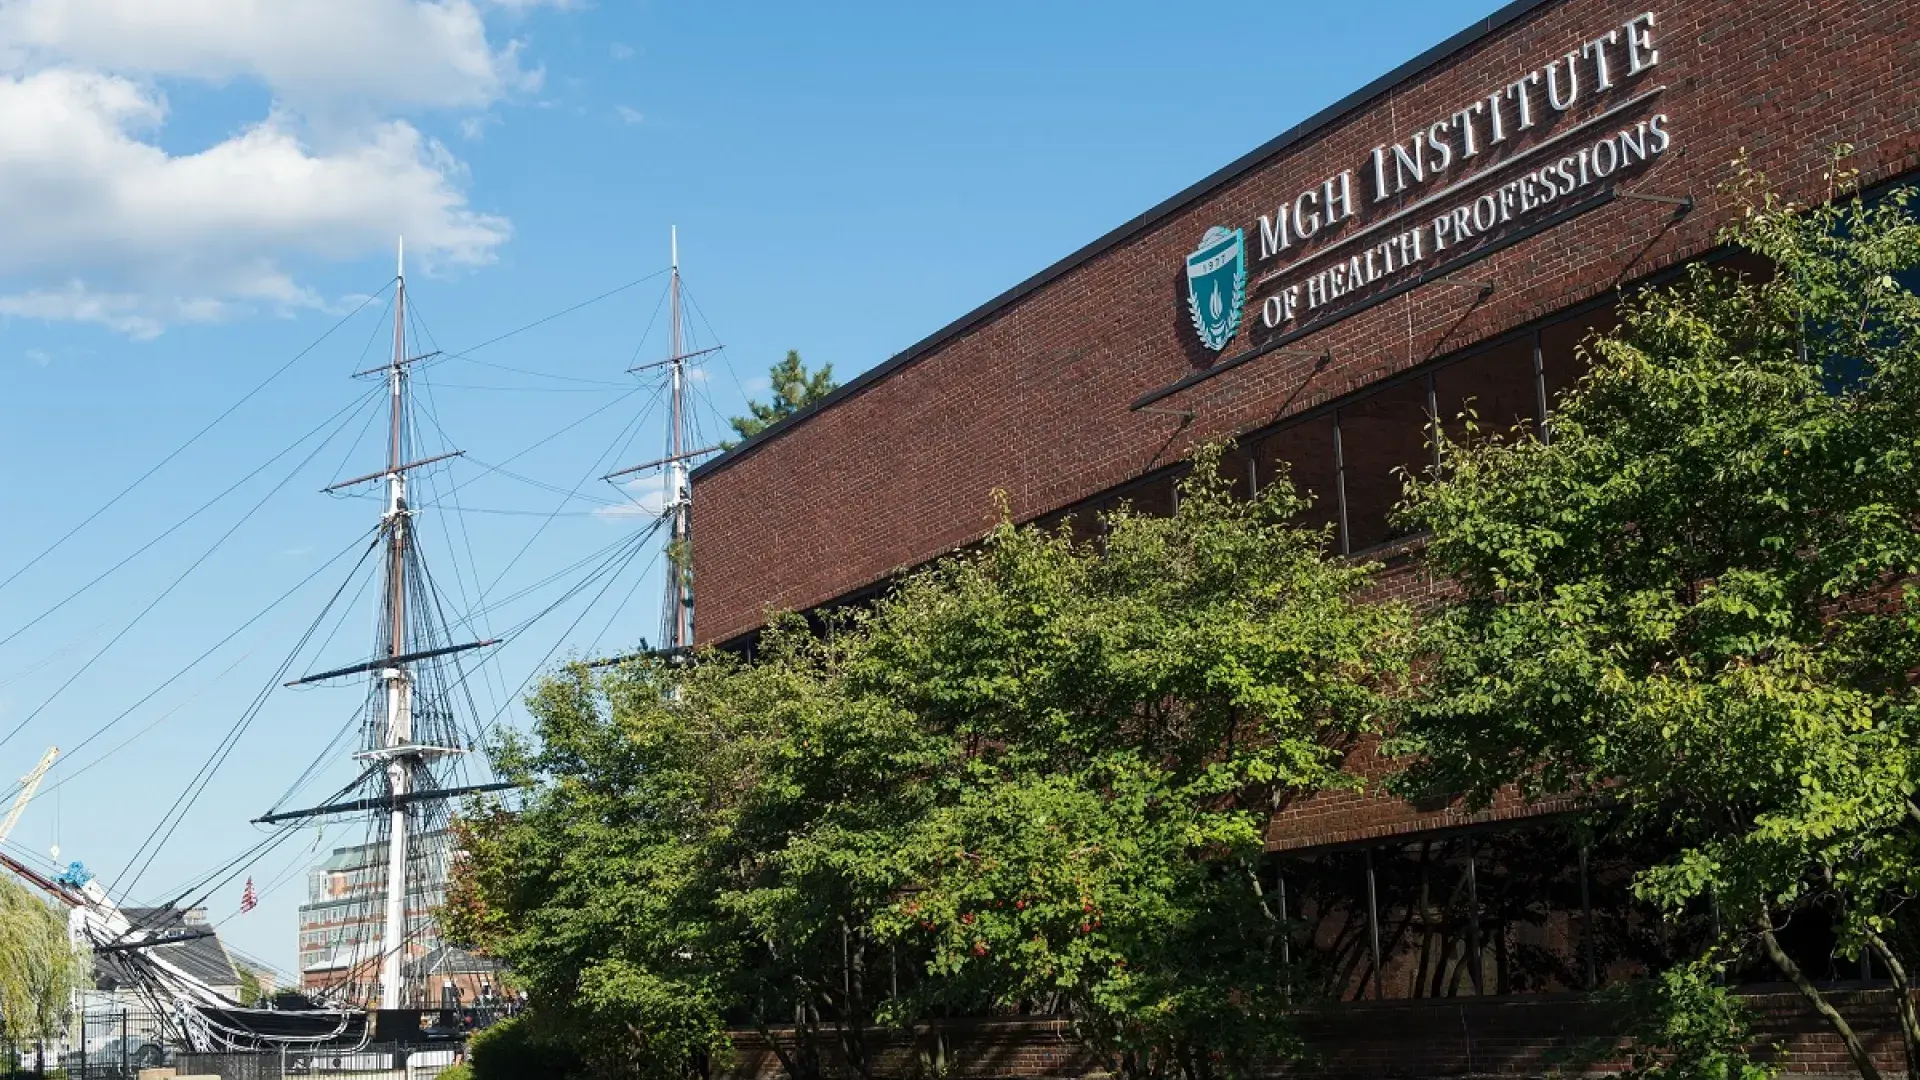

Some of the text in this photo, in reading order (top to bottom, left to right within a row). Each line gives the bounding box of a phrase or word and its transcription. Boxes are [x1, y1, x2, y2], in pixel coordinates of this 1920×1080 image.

[1258, 12, 1660, 260] MGH INSTITUTE
[1263, 113, 1671, 329] OF HEALTH PROFESSIONS
[1202, 254, 1226, 272] 1977
